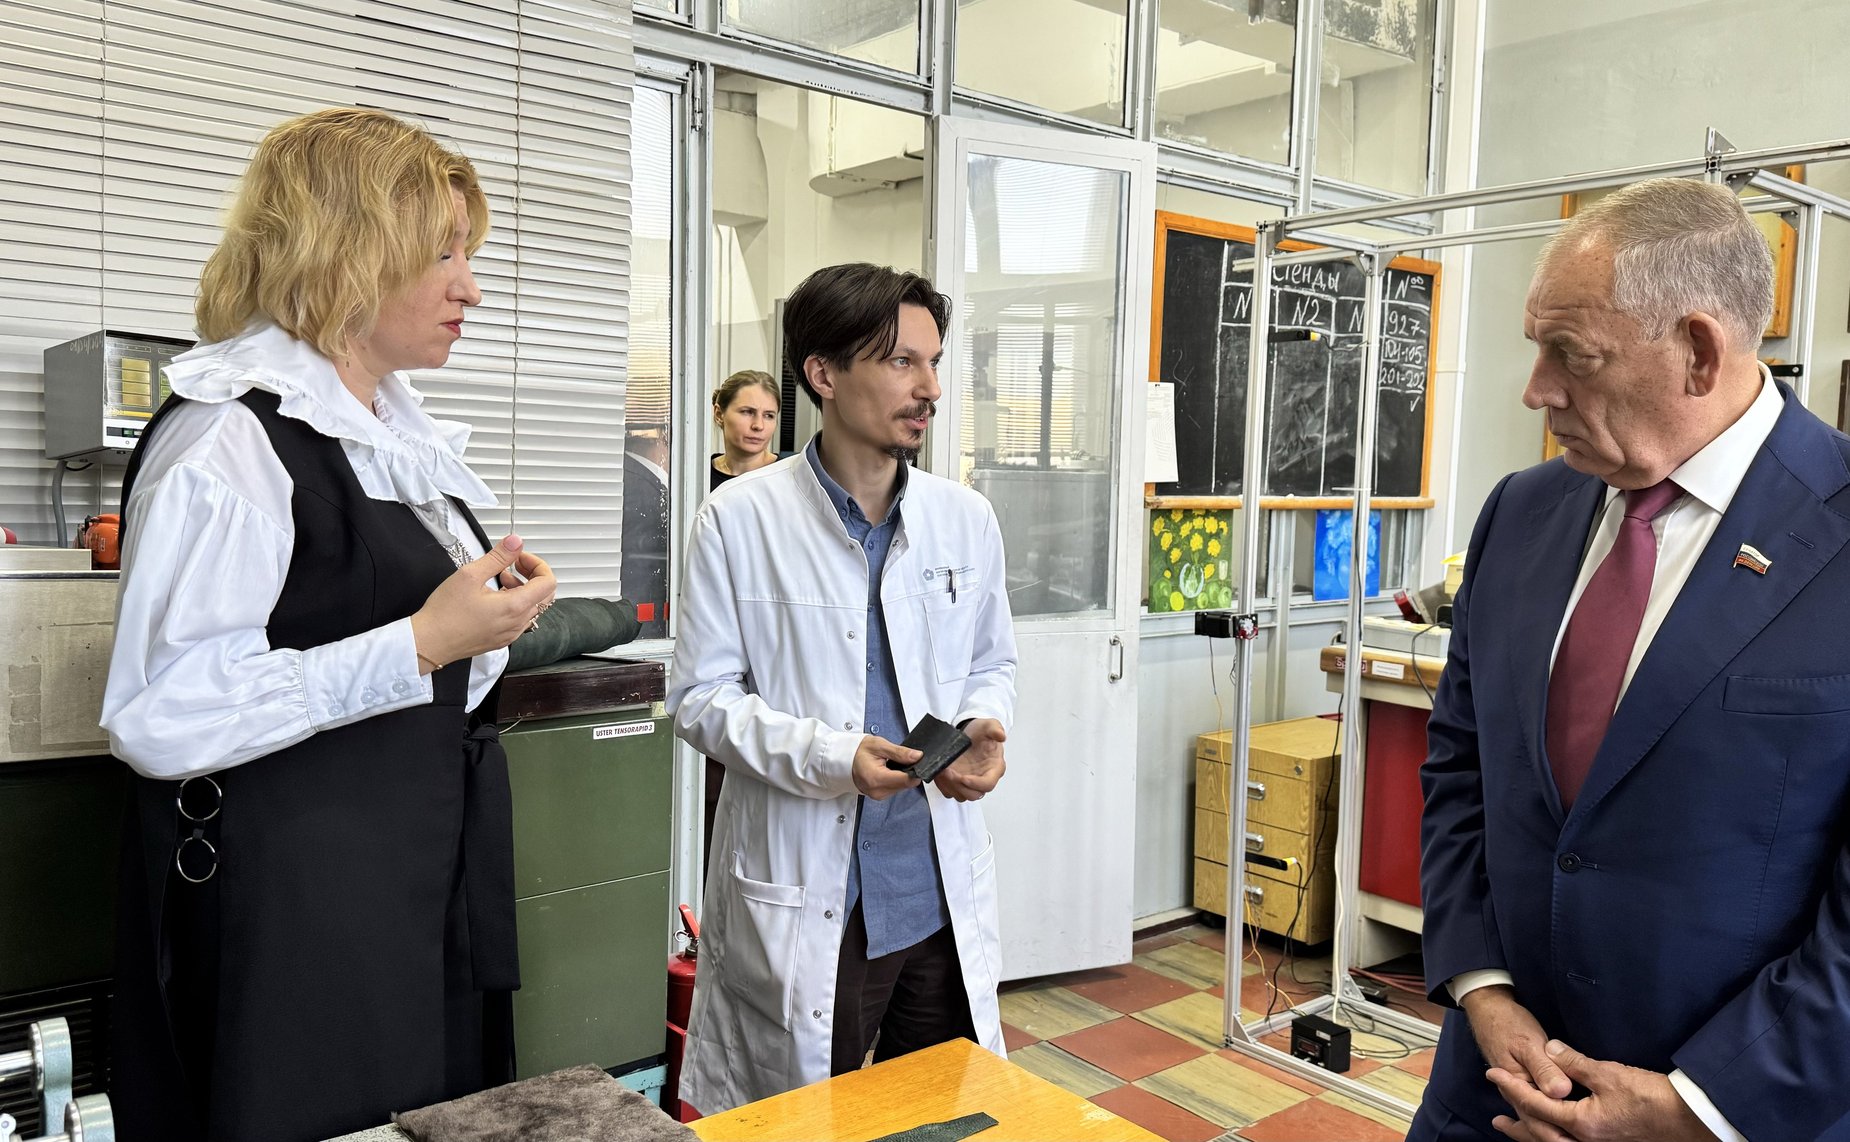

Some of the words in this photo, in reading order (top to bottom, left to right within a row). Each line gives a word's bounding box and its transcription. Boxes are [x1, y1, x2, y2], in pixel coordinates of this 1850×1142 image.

[1233, 287, 1253, 319] N
[1348, 303, 1366, 333] N
[595, 729, 613, 737] USTER
[614, 725, 648, 735] TENSORAPID
